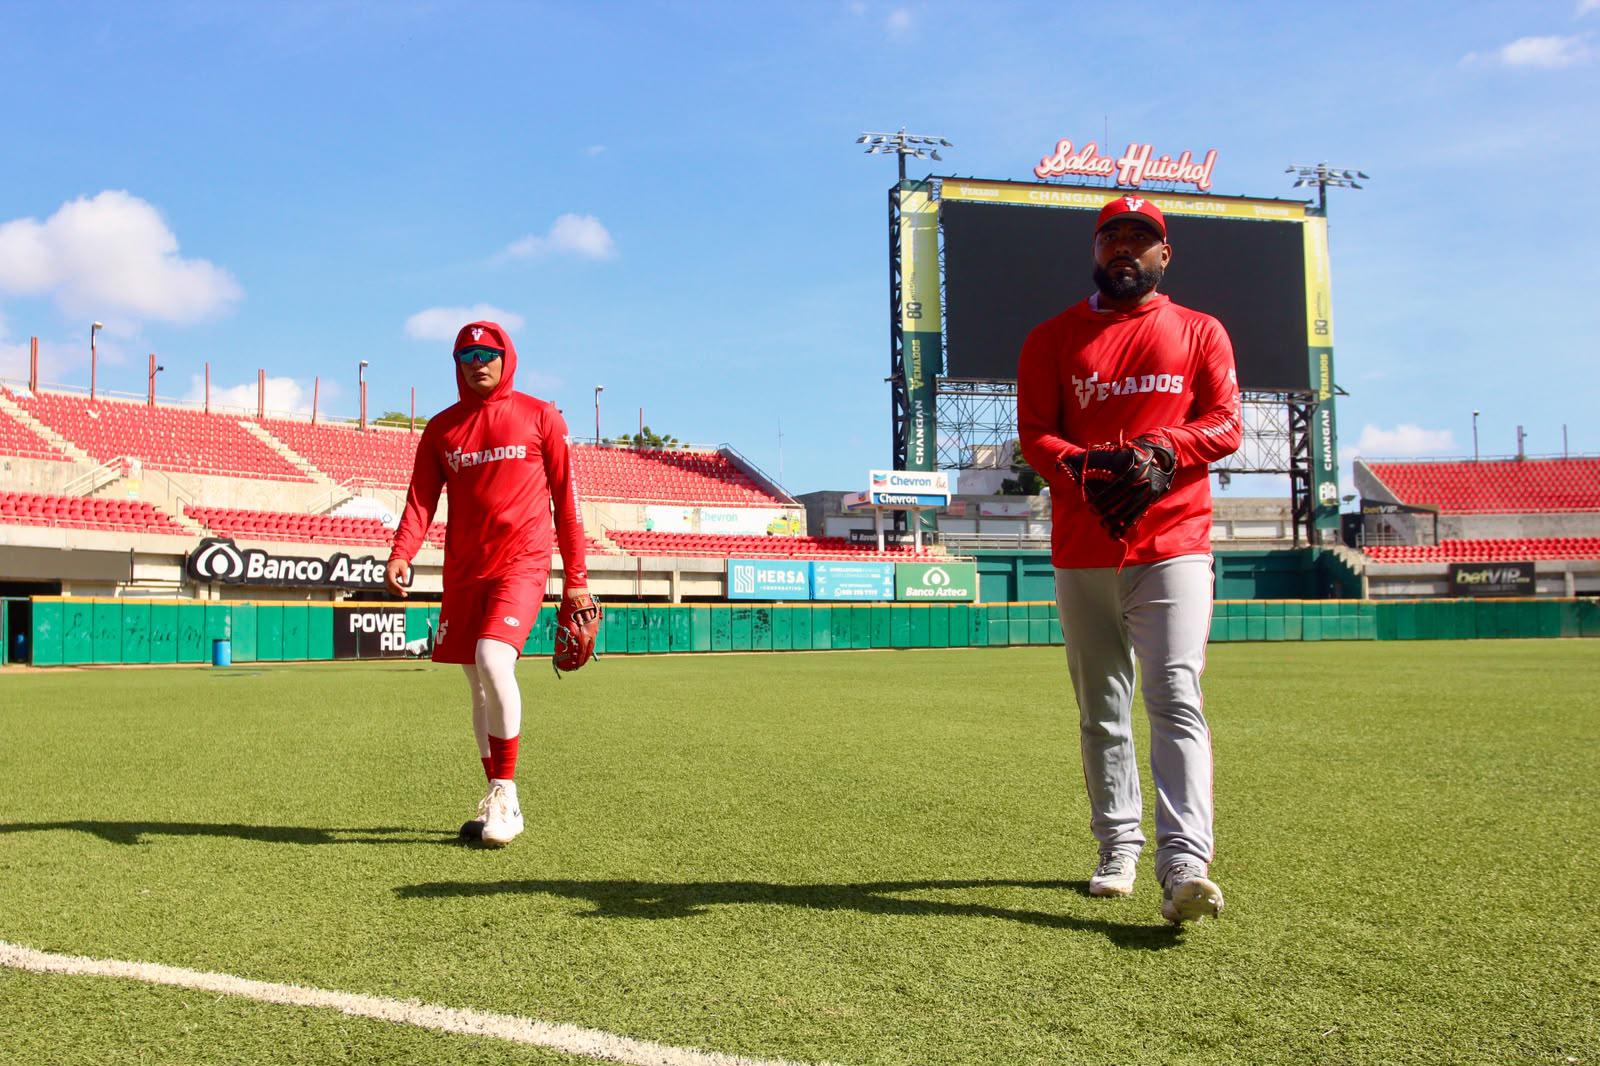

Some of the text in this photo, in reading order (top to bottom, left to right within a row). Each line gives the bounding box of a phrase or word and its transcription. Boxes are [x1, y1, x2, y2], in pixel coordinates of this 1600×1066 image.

[1034, 138, 1218, 192] Salsa Huichol
[1028, 190, 1105, 204] CHANGAN
[1154, 199, 1226, 213] CHANGAN
[1071, 371, 1185, 410] VENADOS
[915, 399, 925, 465] CHANGAN
[1321, 409, 1333, 471] CHANGAN
[445, 445, 527, 474] VENADOS
[890, 475, 932, 487] Chevron
[879, 493, 918, 505] Chevron
[247, 553, 411, 584] Banco Azte
[757, 569, 806, 584] HERSA
[905, 587, 968, 597] Banco Azteca
